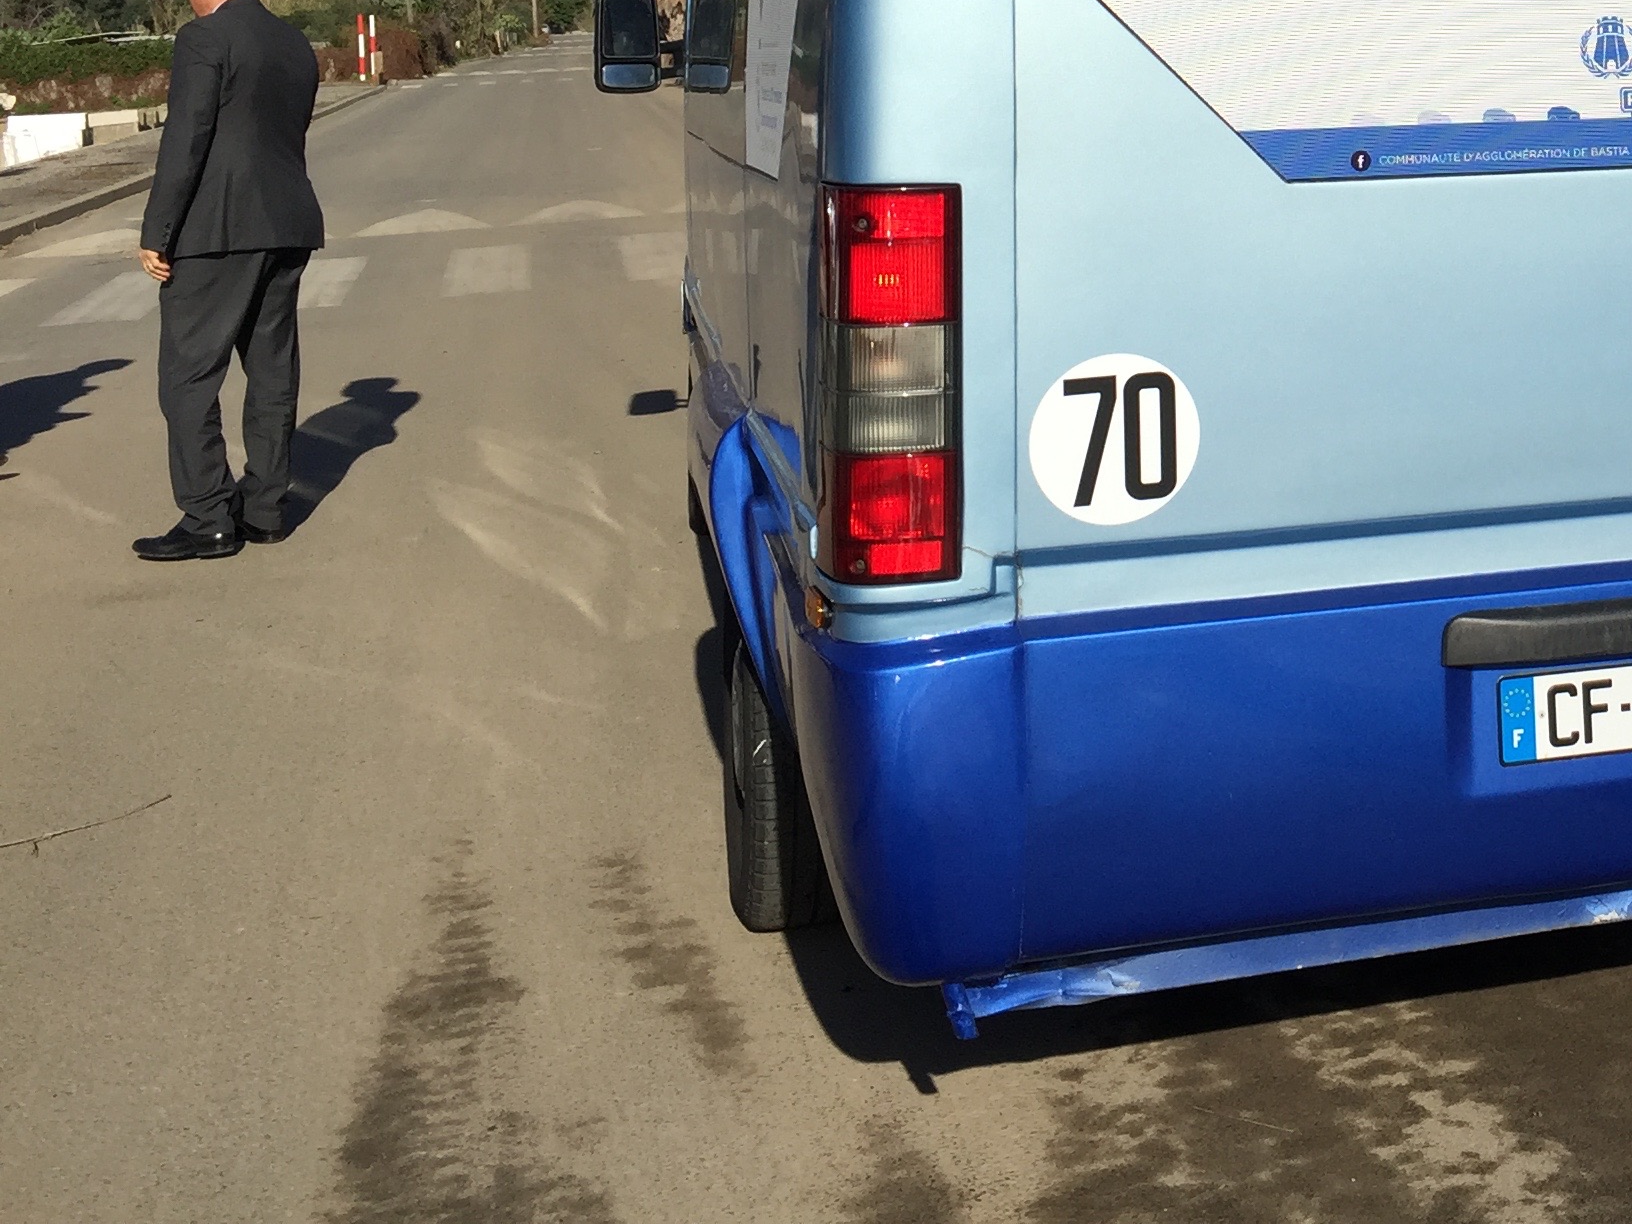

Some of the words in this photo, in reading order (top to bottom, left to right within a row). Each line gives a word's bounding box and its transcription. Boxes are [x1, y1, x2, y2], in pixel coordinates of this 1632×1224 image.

[1379, 151, 1461, 165] COMMUNAUTÉ
[1464, 147, 1570, 162] D'AGGLOMÉRATION
[1573, 147, 1588, 157] DE
[1590, 146, 1631, 157] BASTIA
[1063, 371, 1177, 507] 70
[1512, 728, 1525, 748] F
